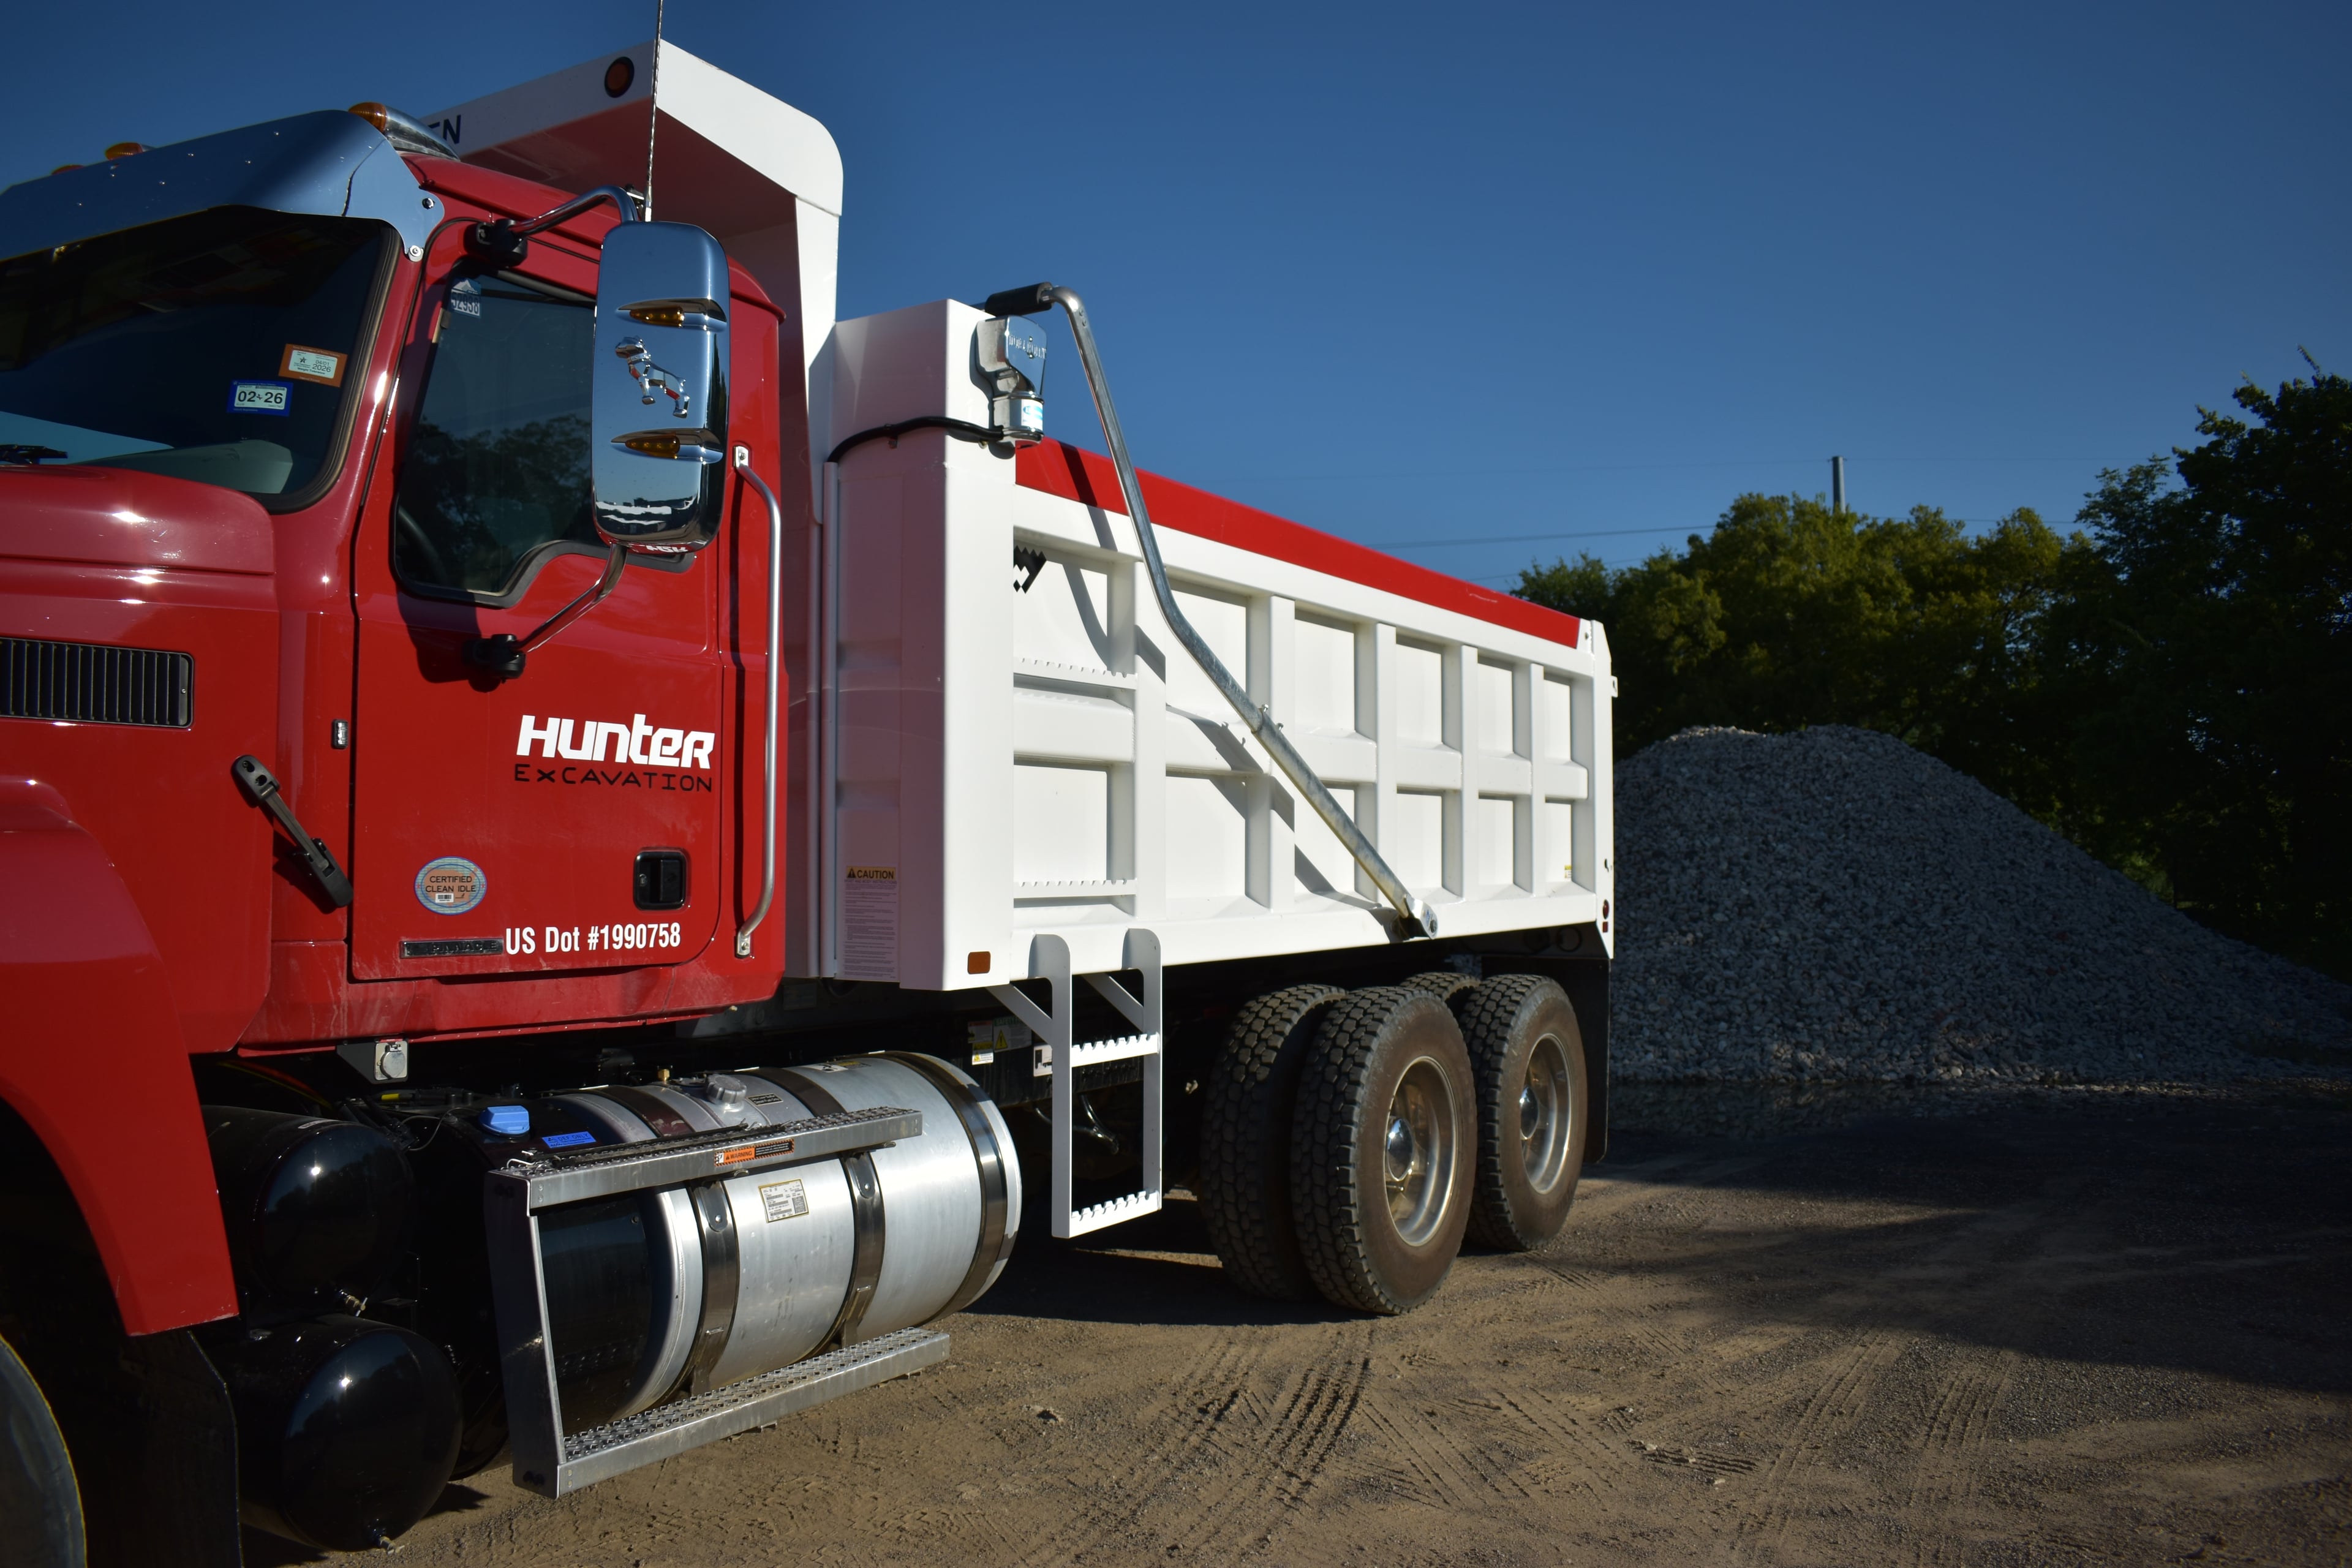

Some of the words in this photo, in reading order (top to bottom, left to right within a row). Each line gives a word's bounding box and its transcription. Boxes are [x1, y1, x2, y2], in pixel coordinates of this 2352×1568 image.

[428, 115, 461, 144] N
[312, 364, 331, 372] 2026
[238, 391, 256, 402] 02
[264, 392, 283, 404] 26
[514, 763, 712, 793] EXCAVATION
[857, 870, 894, 879] CAUTION
[505, 927, 536, 954] US
[545, 926, 580, 953] Dot
[587, 922, 681, 951] #1990758
